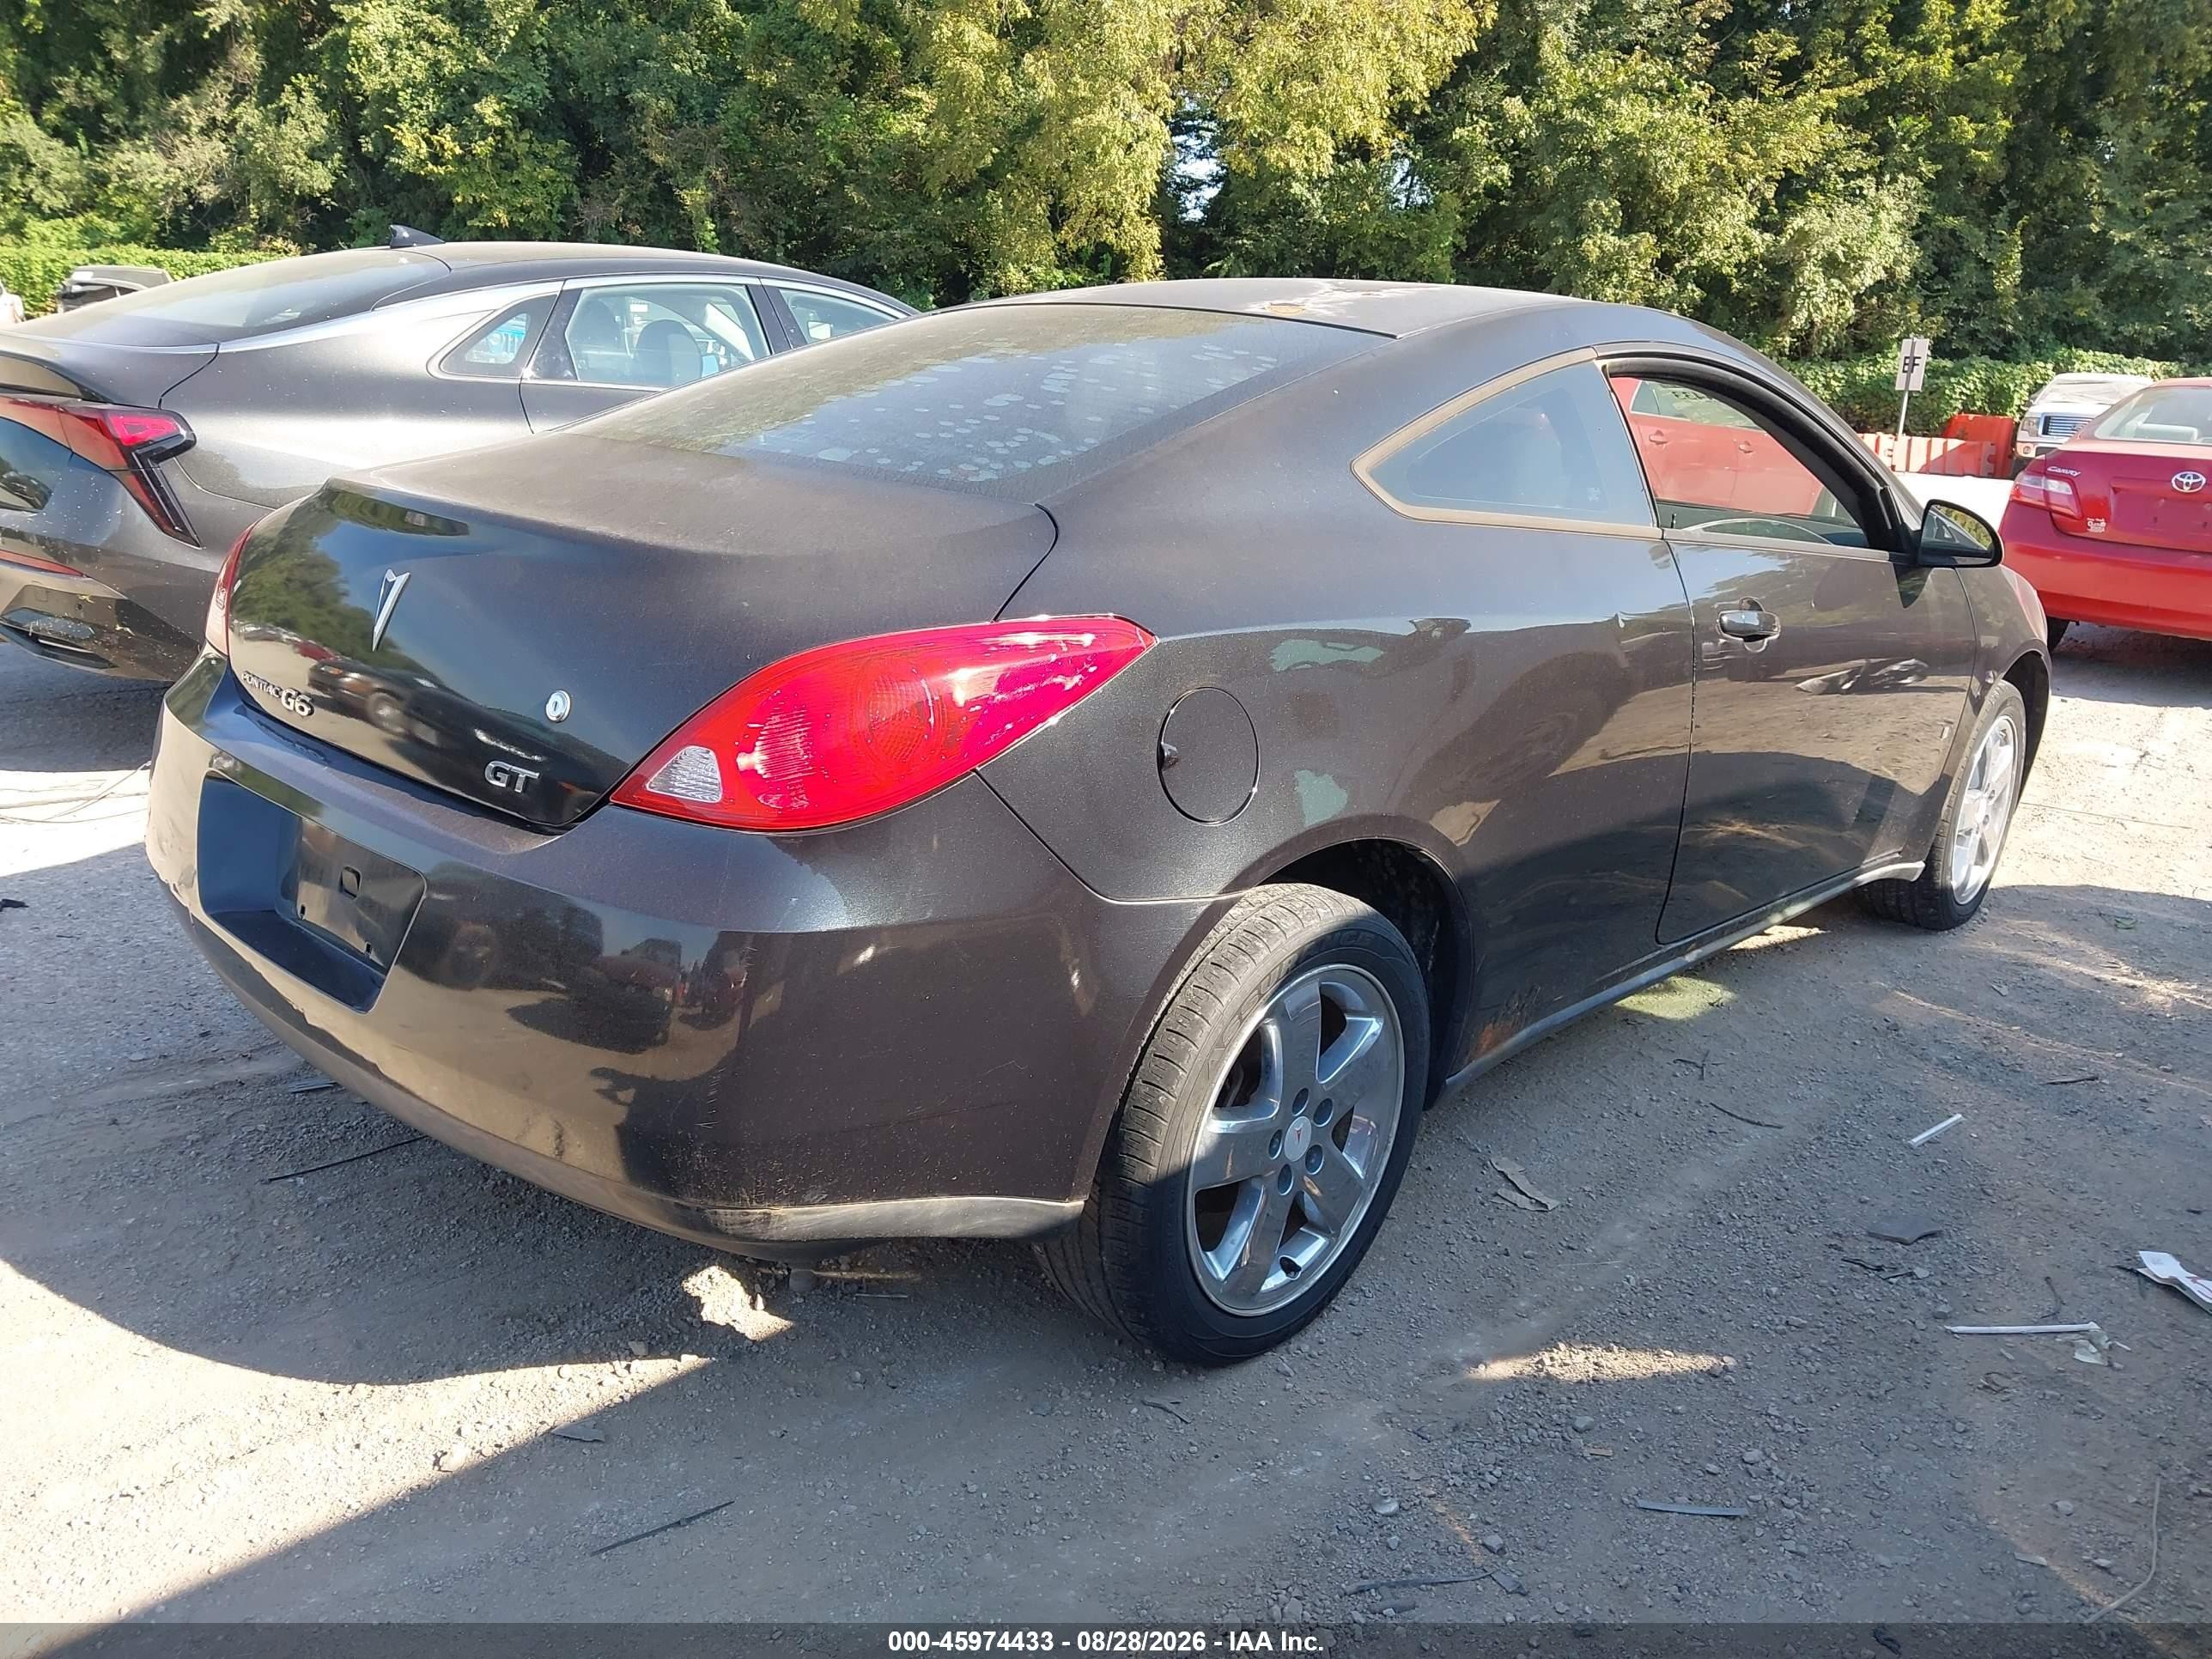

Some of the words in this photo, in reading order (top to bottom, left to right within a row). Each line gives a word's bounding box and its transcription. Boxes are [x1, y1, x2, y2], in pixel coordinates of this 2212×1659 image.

[241, 671, 283, 698] PONTIAC
[281, 687, 314, 716] G6
[484, 760, 540, 793] GT
